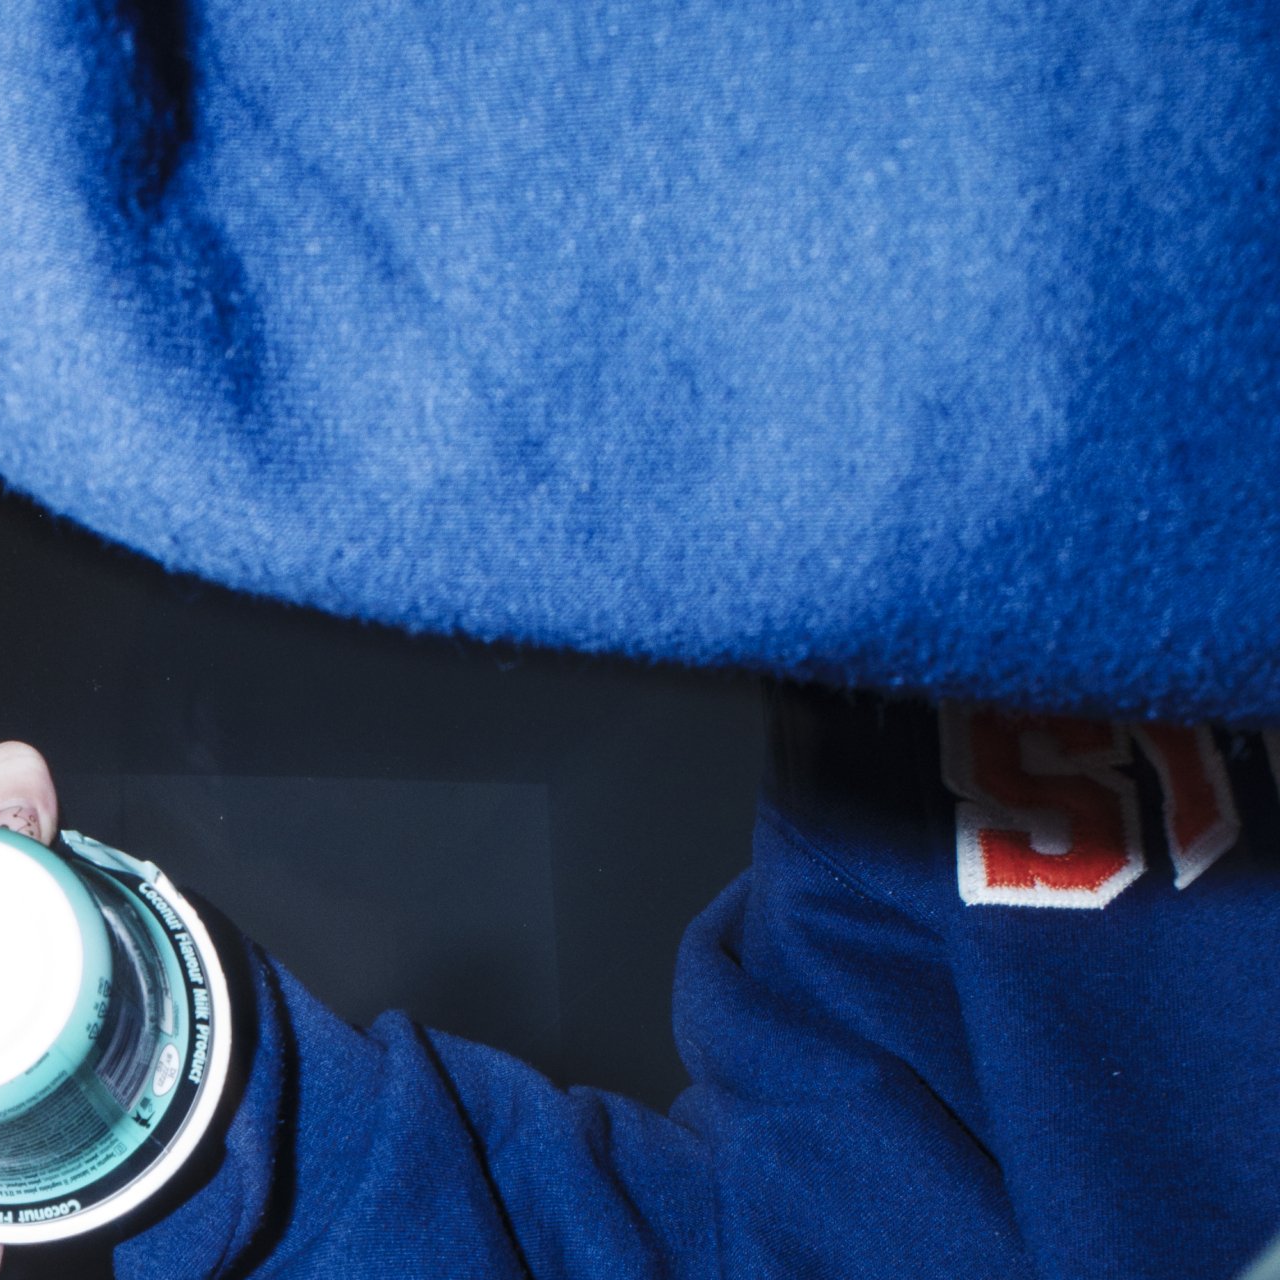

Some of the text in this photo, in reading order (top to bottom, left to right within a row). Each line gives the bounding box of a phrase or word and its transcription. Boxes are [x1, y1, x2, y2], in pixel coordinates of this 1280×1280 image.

[138, 882, 211, 1084] Coconut Flavour Milk Product
[18, 1199, 82, 1224] Coconut
